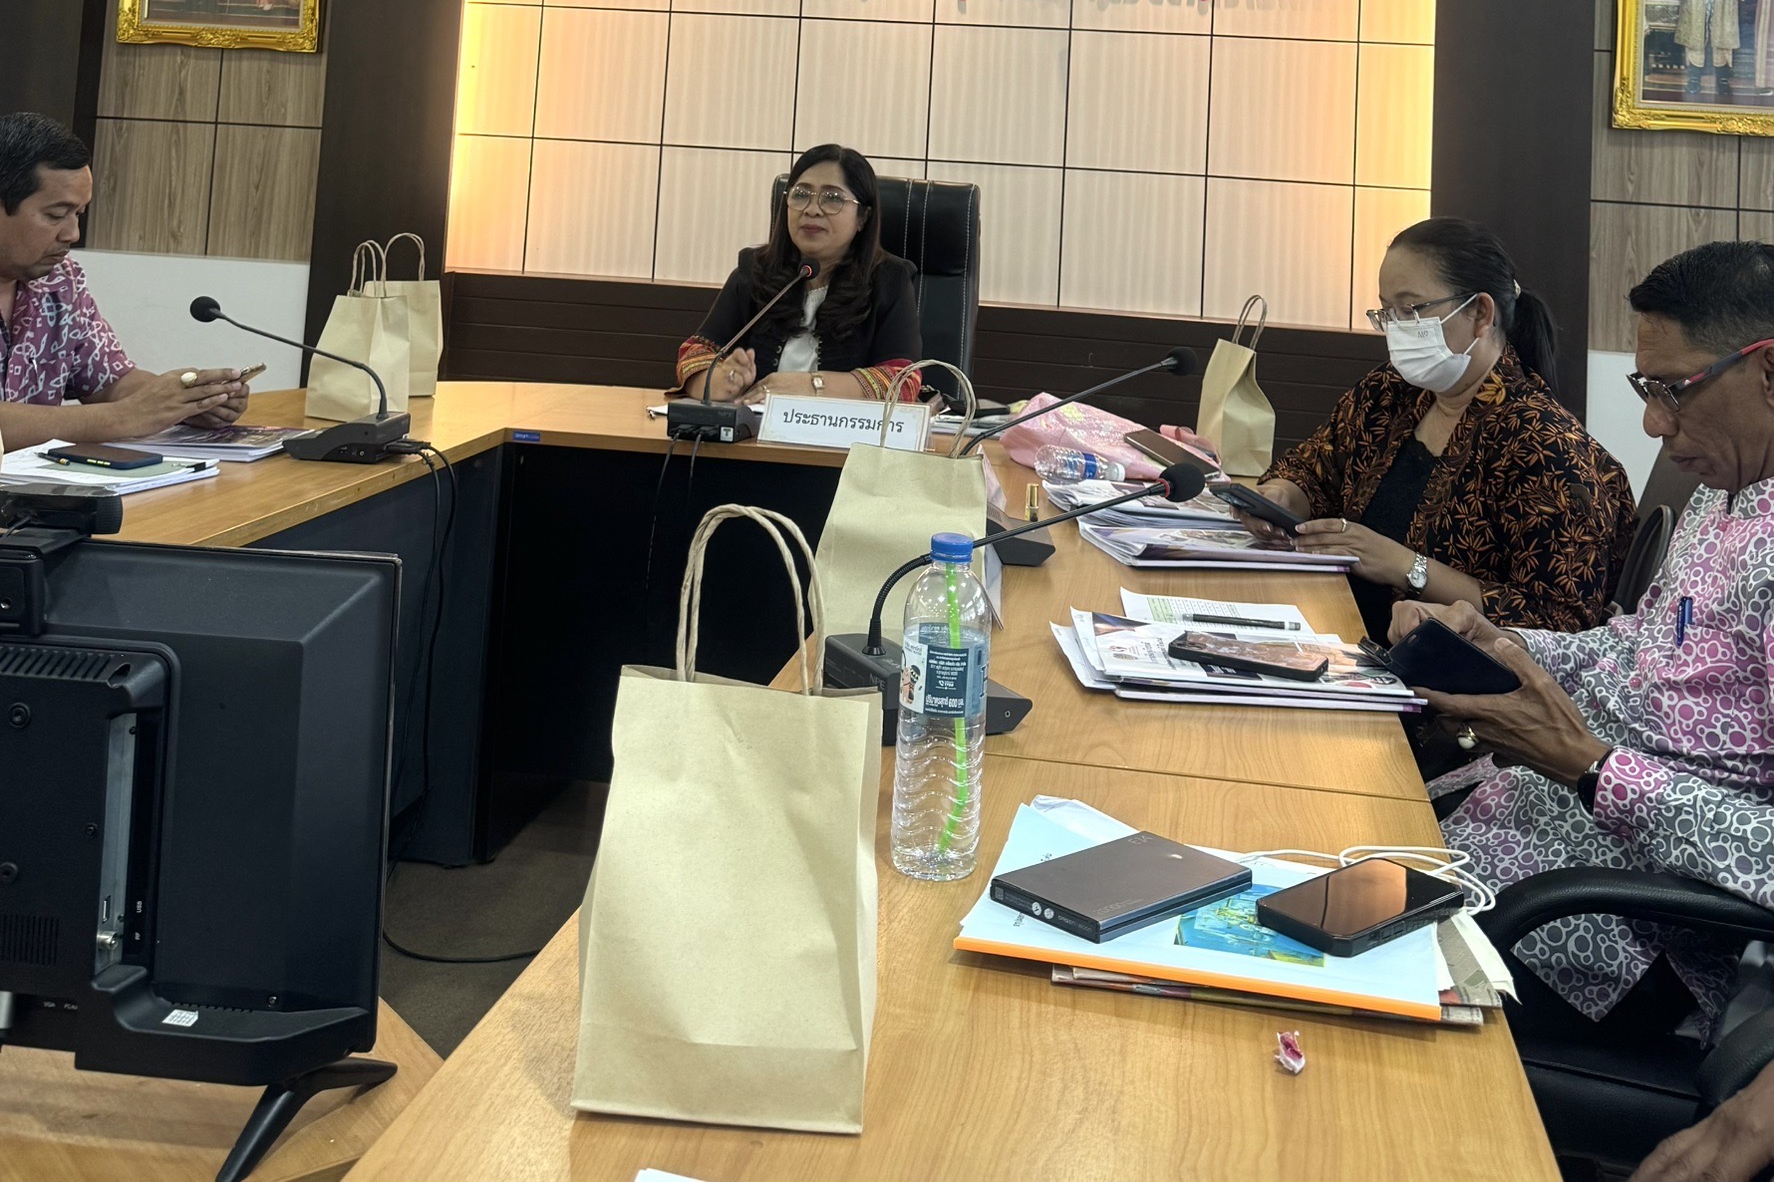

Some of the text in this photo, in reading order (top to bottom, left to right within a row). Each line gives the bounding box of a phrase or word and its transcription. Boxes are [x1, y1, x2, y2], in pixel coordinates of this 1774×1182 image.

[783, 409, 905, 433] ประธานกรรมการ
[870, 673, 886, 690] NPE
